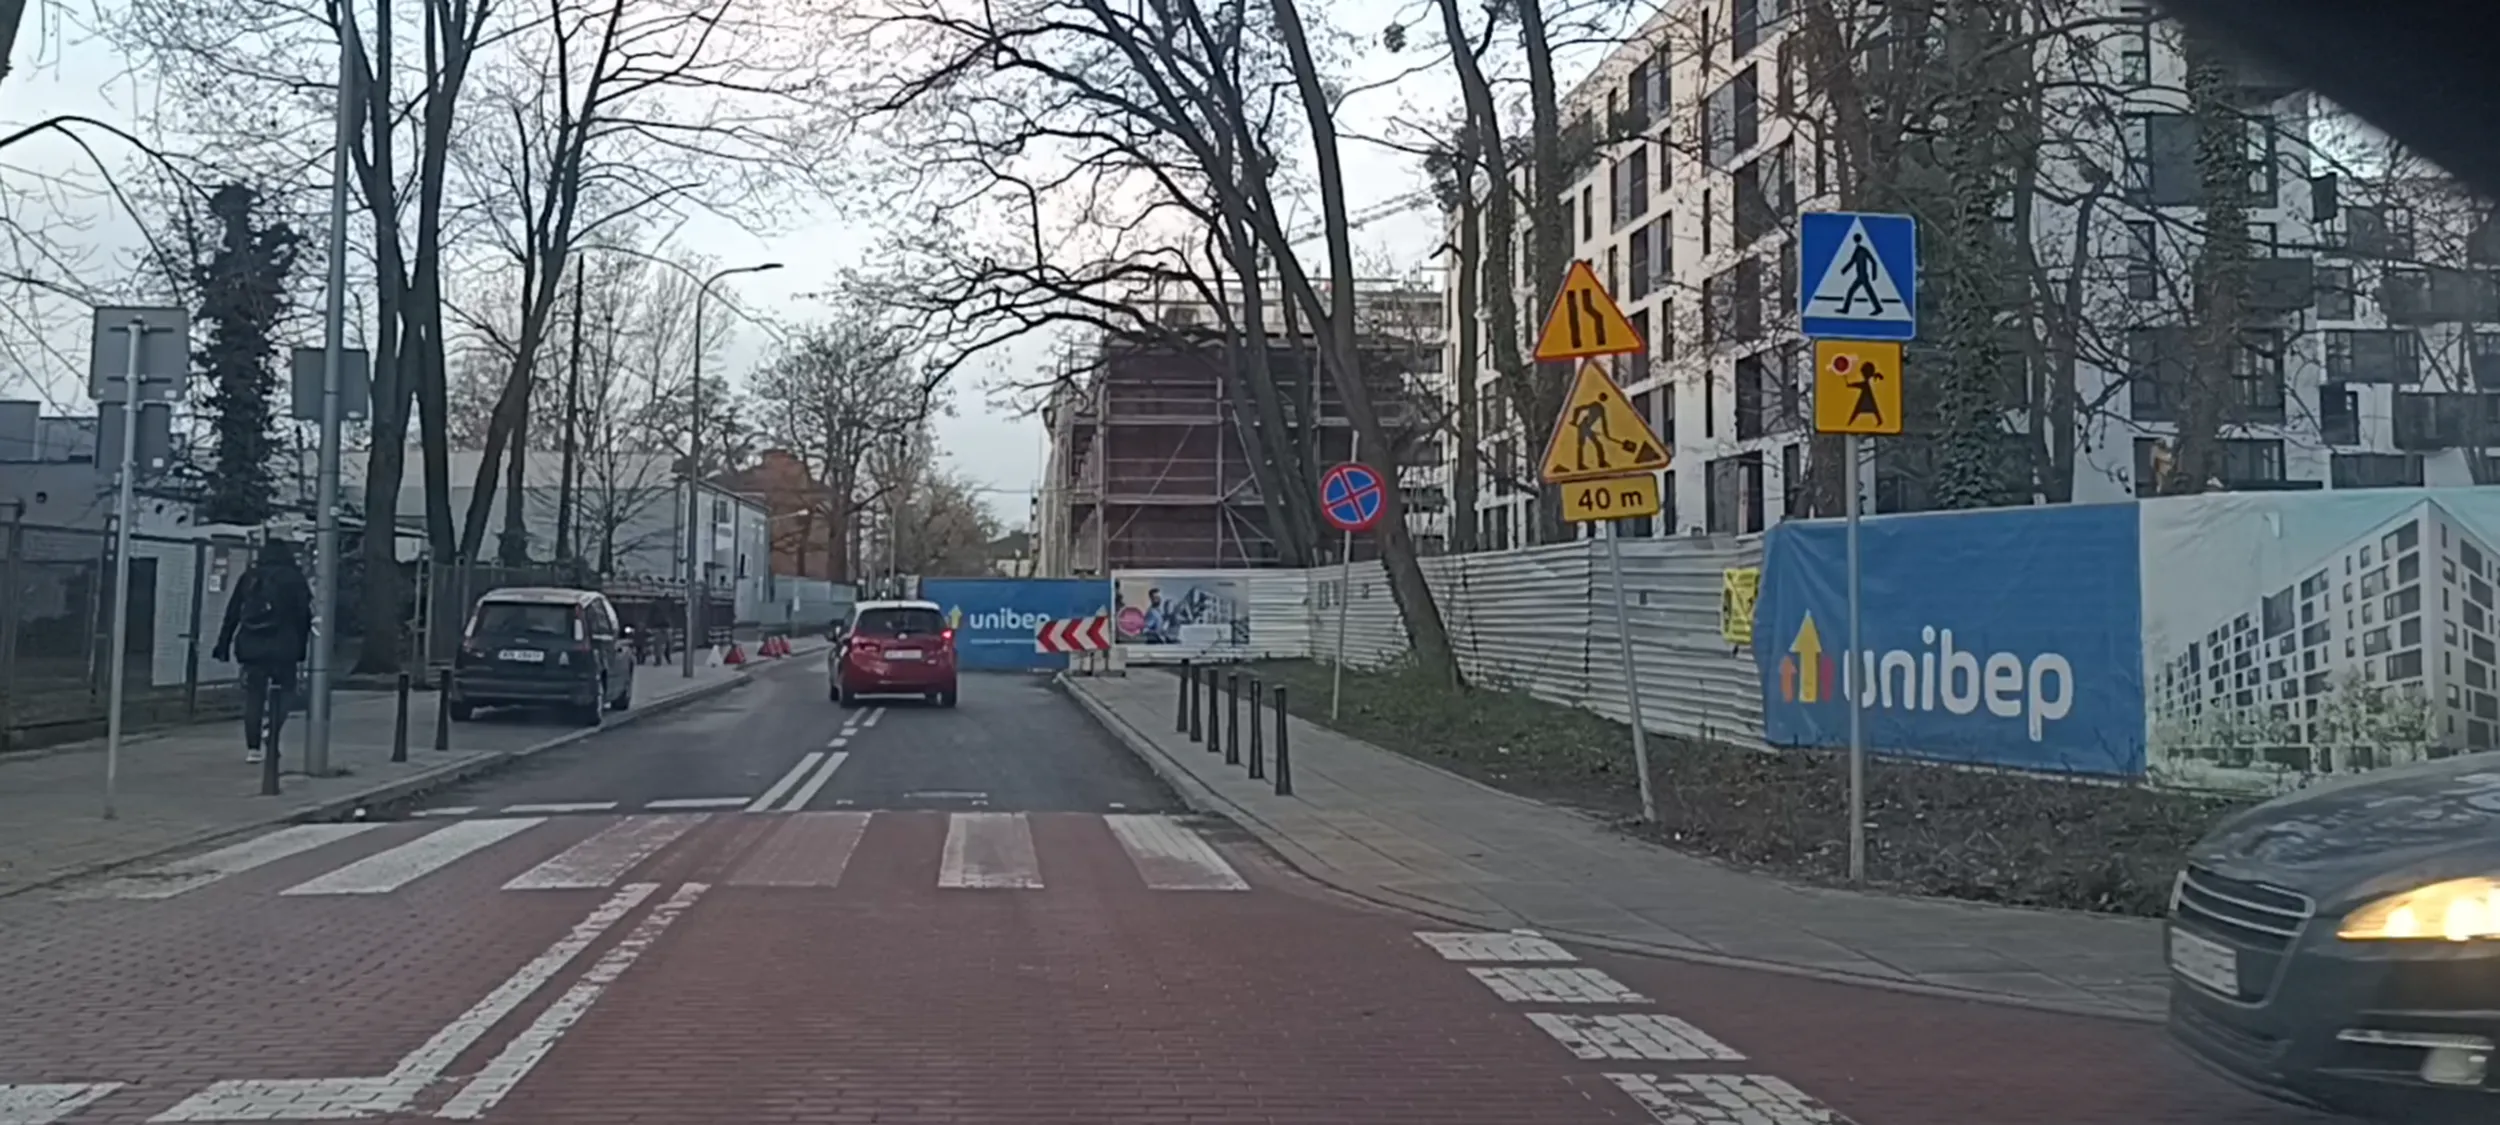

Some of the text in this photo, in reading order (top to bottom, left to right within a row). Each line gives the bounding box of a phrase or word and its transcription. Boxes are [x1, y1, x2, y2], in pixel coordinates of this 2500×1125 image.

[1578, 488, 1643, 512] 40 m
[1843, 625, 2074, 742] unibep
